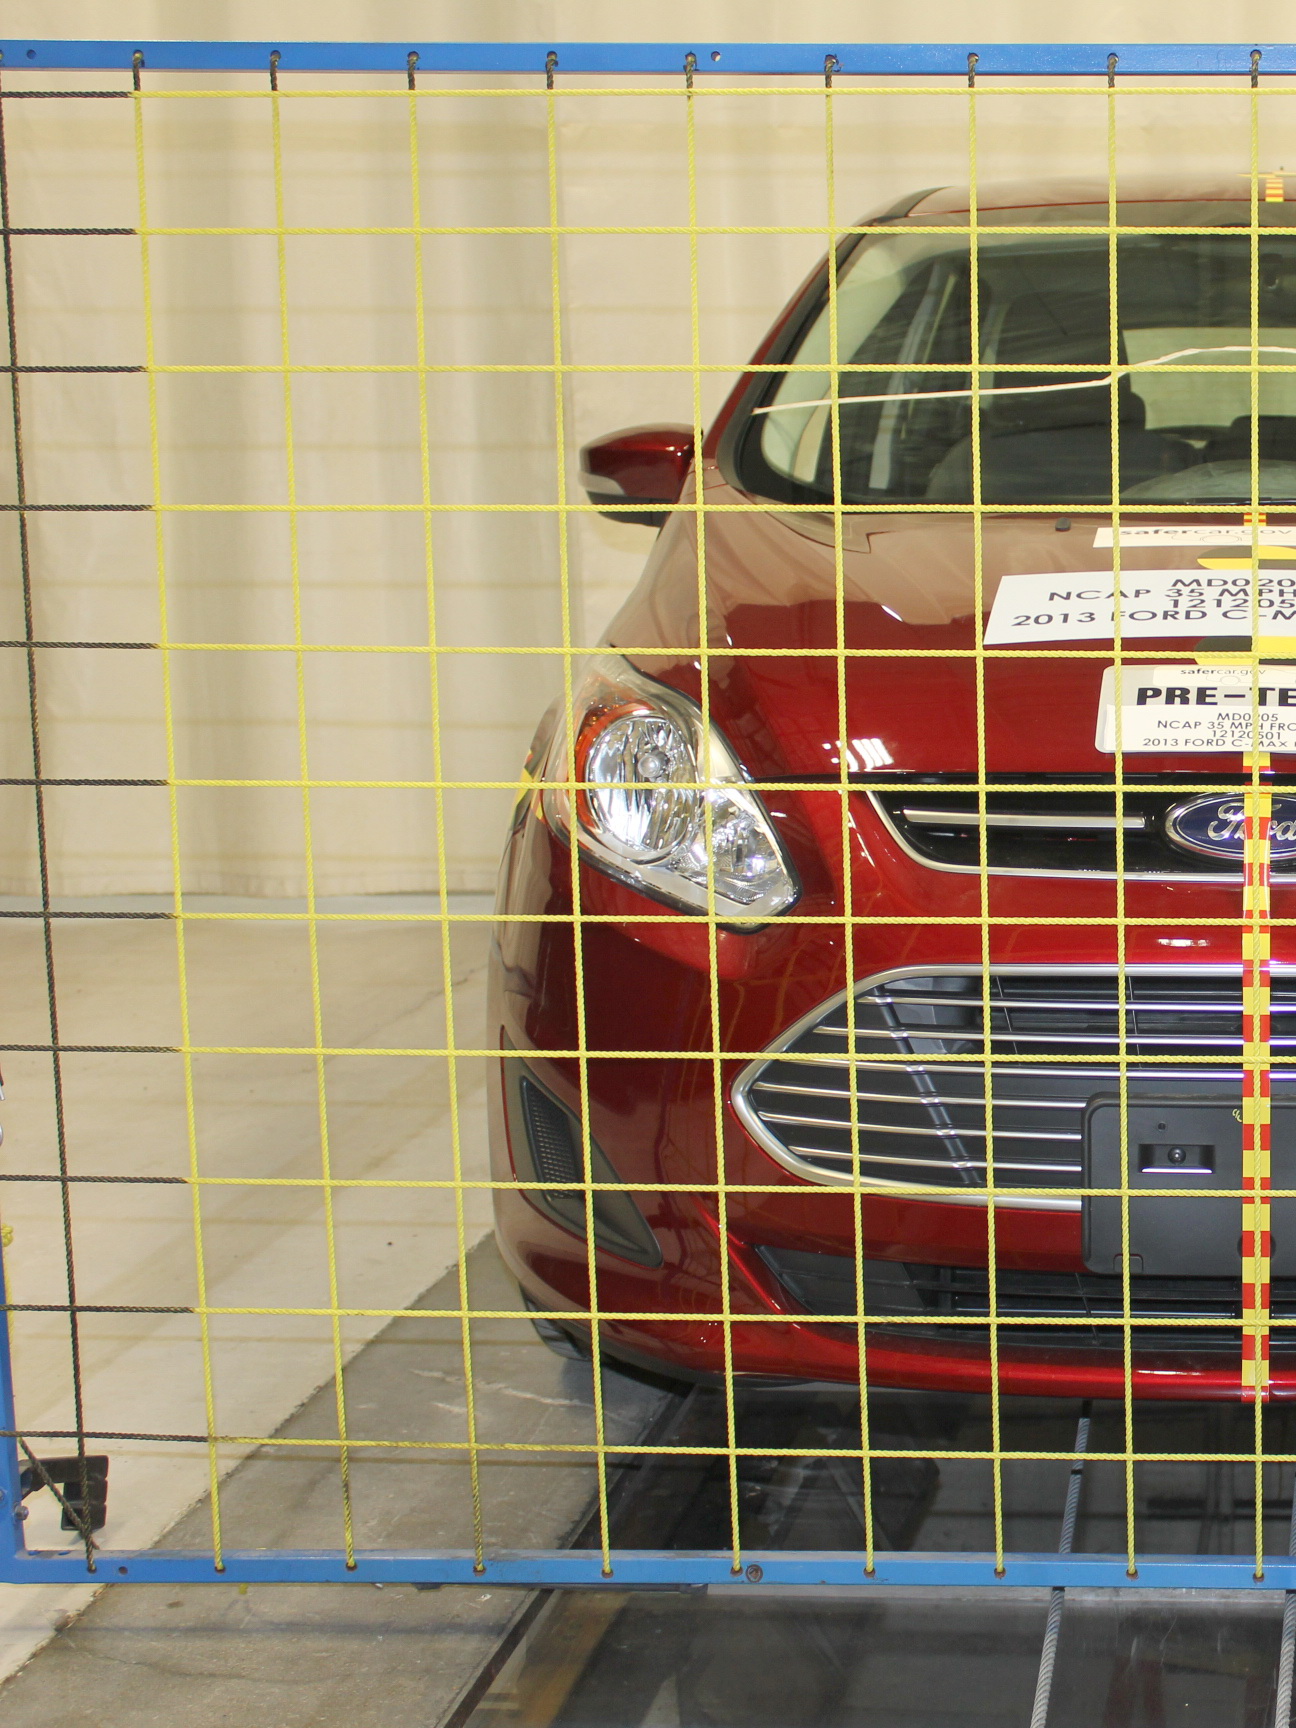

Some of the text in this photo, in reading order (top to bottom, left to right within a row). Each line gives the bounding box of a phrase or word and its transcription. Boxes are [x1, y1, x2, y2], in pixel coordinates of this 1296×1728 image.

[1048, 589, 1151, 601] NCAP
[1164, 588, 1204, 598] 35
[1011, 612, 1096, 626] 2013
[1216, 712, 1279, 722] MD005
[1157, 720, 1202, 730] NCAP
[1207, 721, 1225, 730] 35
[1142, 738, 1179, 747] 2013
[1184, 738, 1226, 747] FORD
